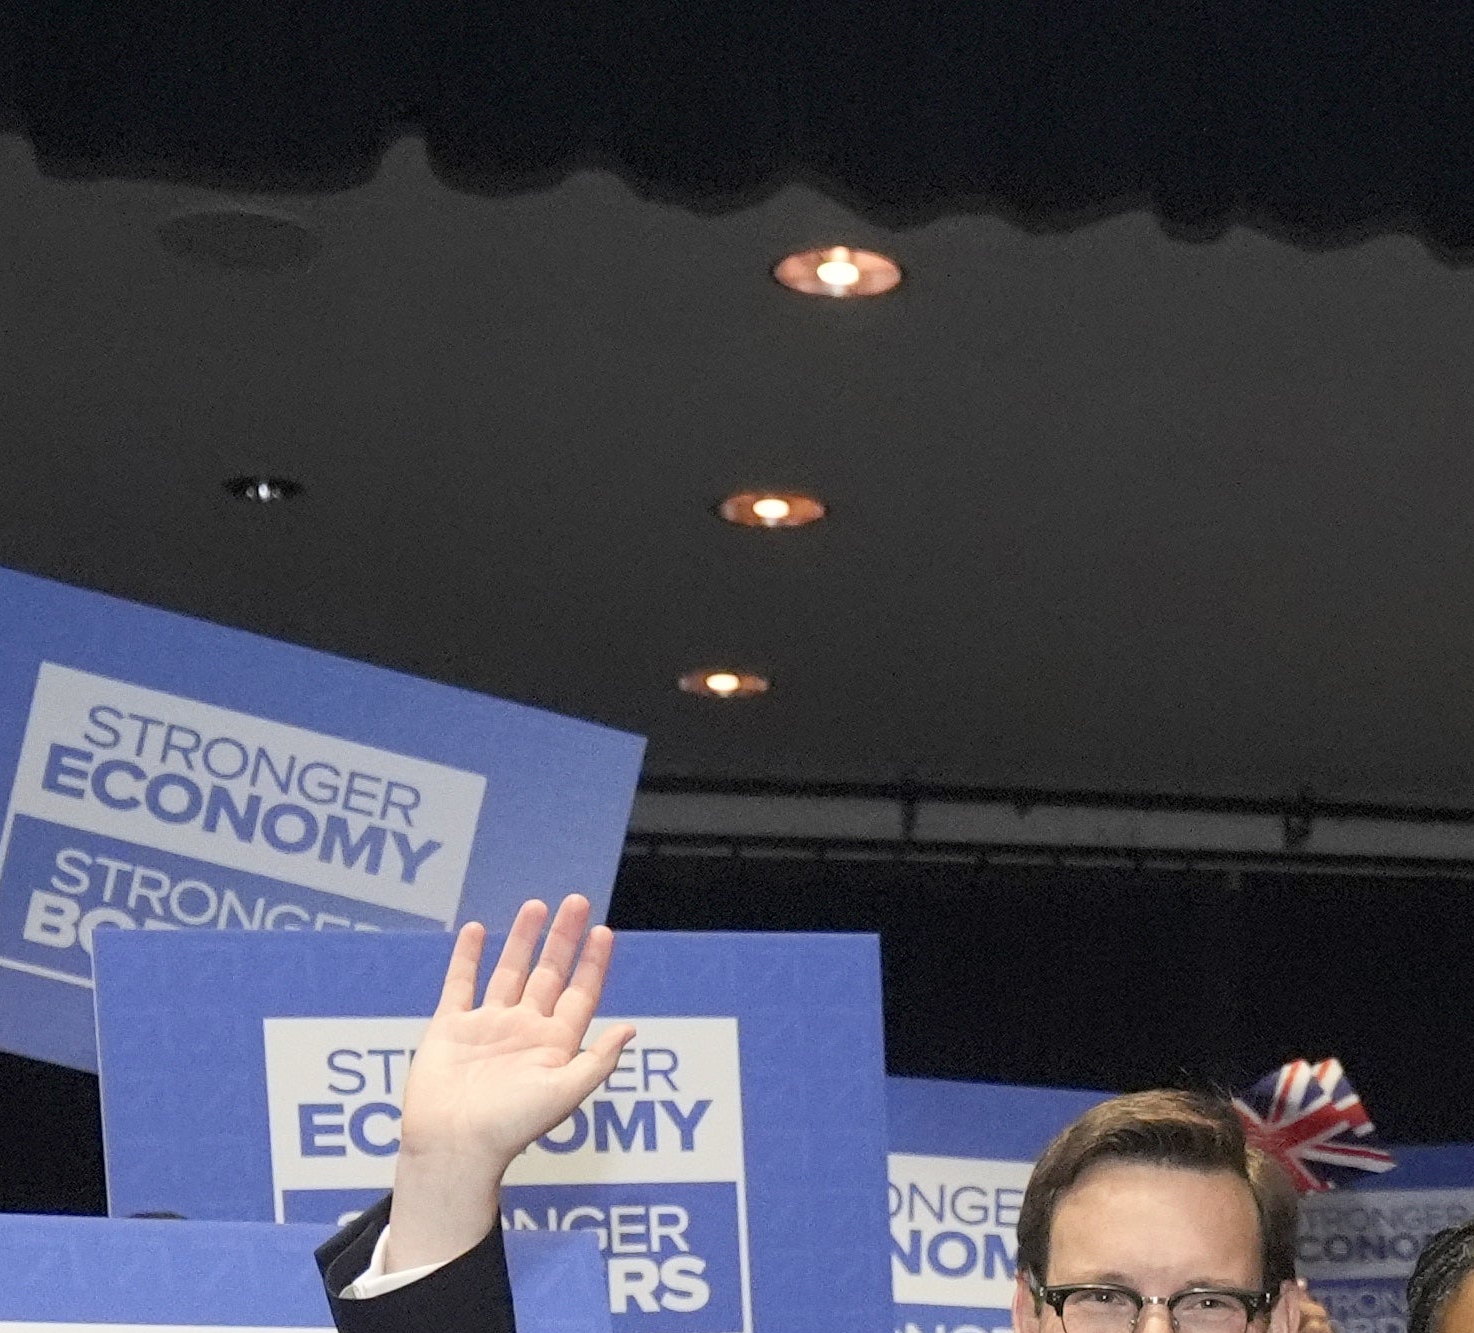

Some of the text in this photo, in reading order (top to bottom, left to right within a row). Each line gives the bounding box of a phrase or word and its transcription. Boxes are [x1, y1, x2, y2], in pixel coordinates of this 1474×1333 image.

[41, 742, 444, 885] ECONOMY
[83, 704, 422, 828] STRONGER
[299, 1099, 714, 1157] ECOMY
